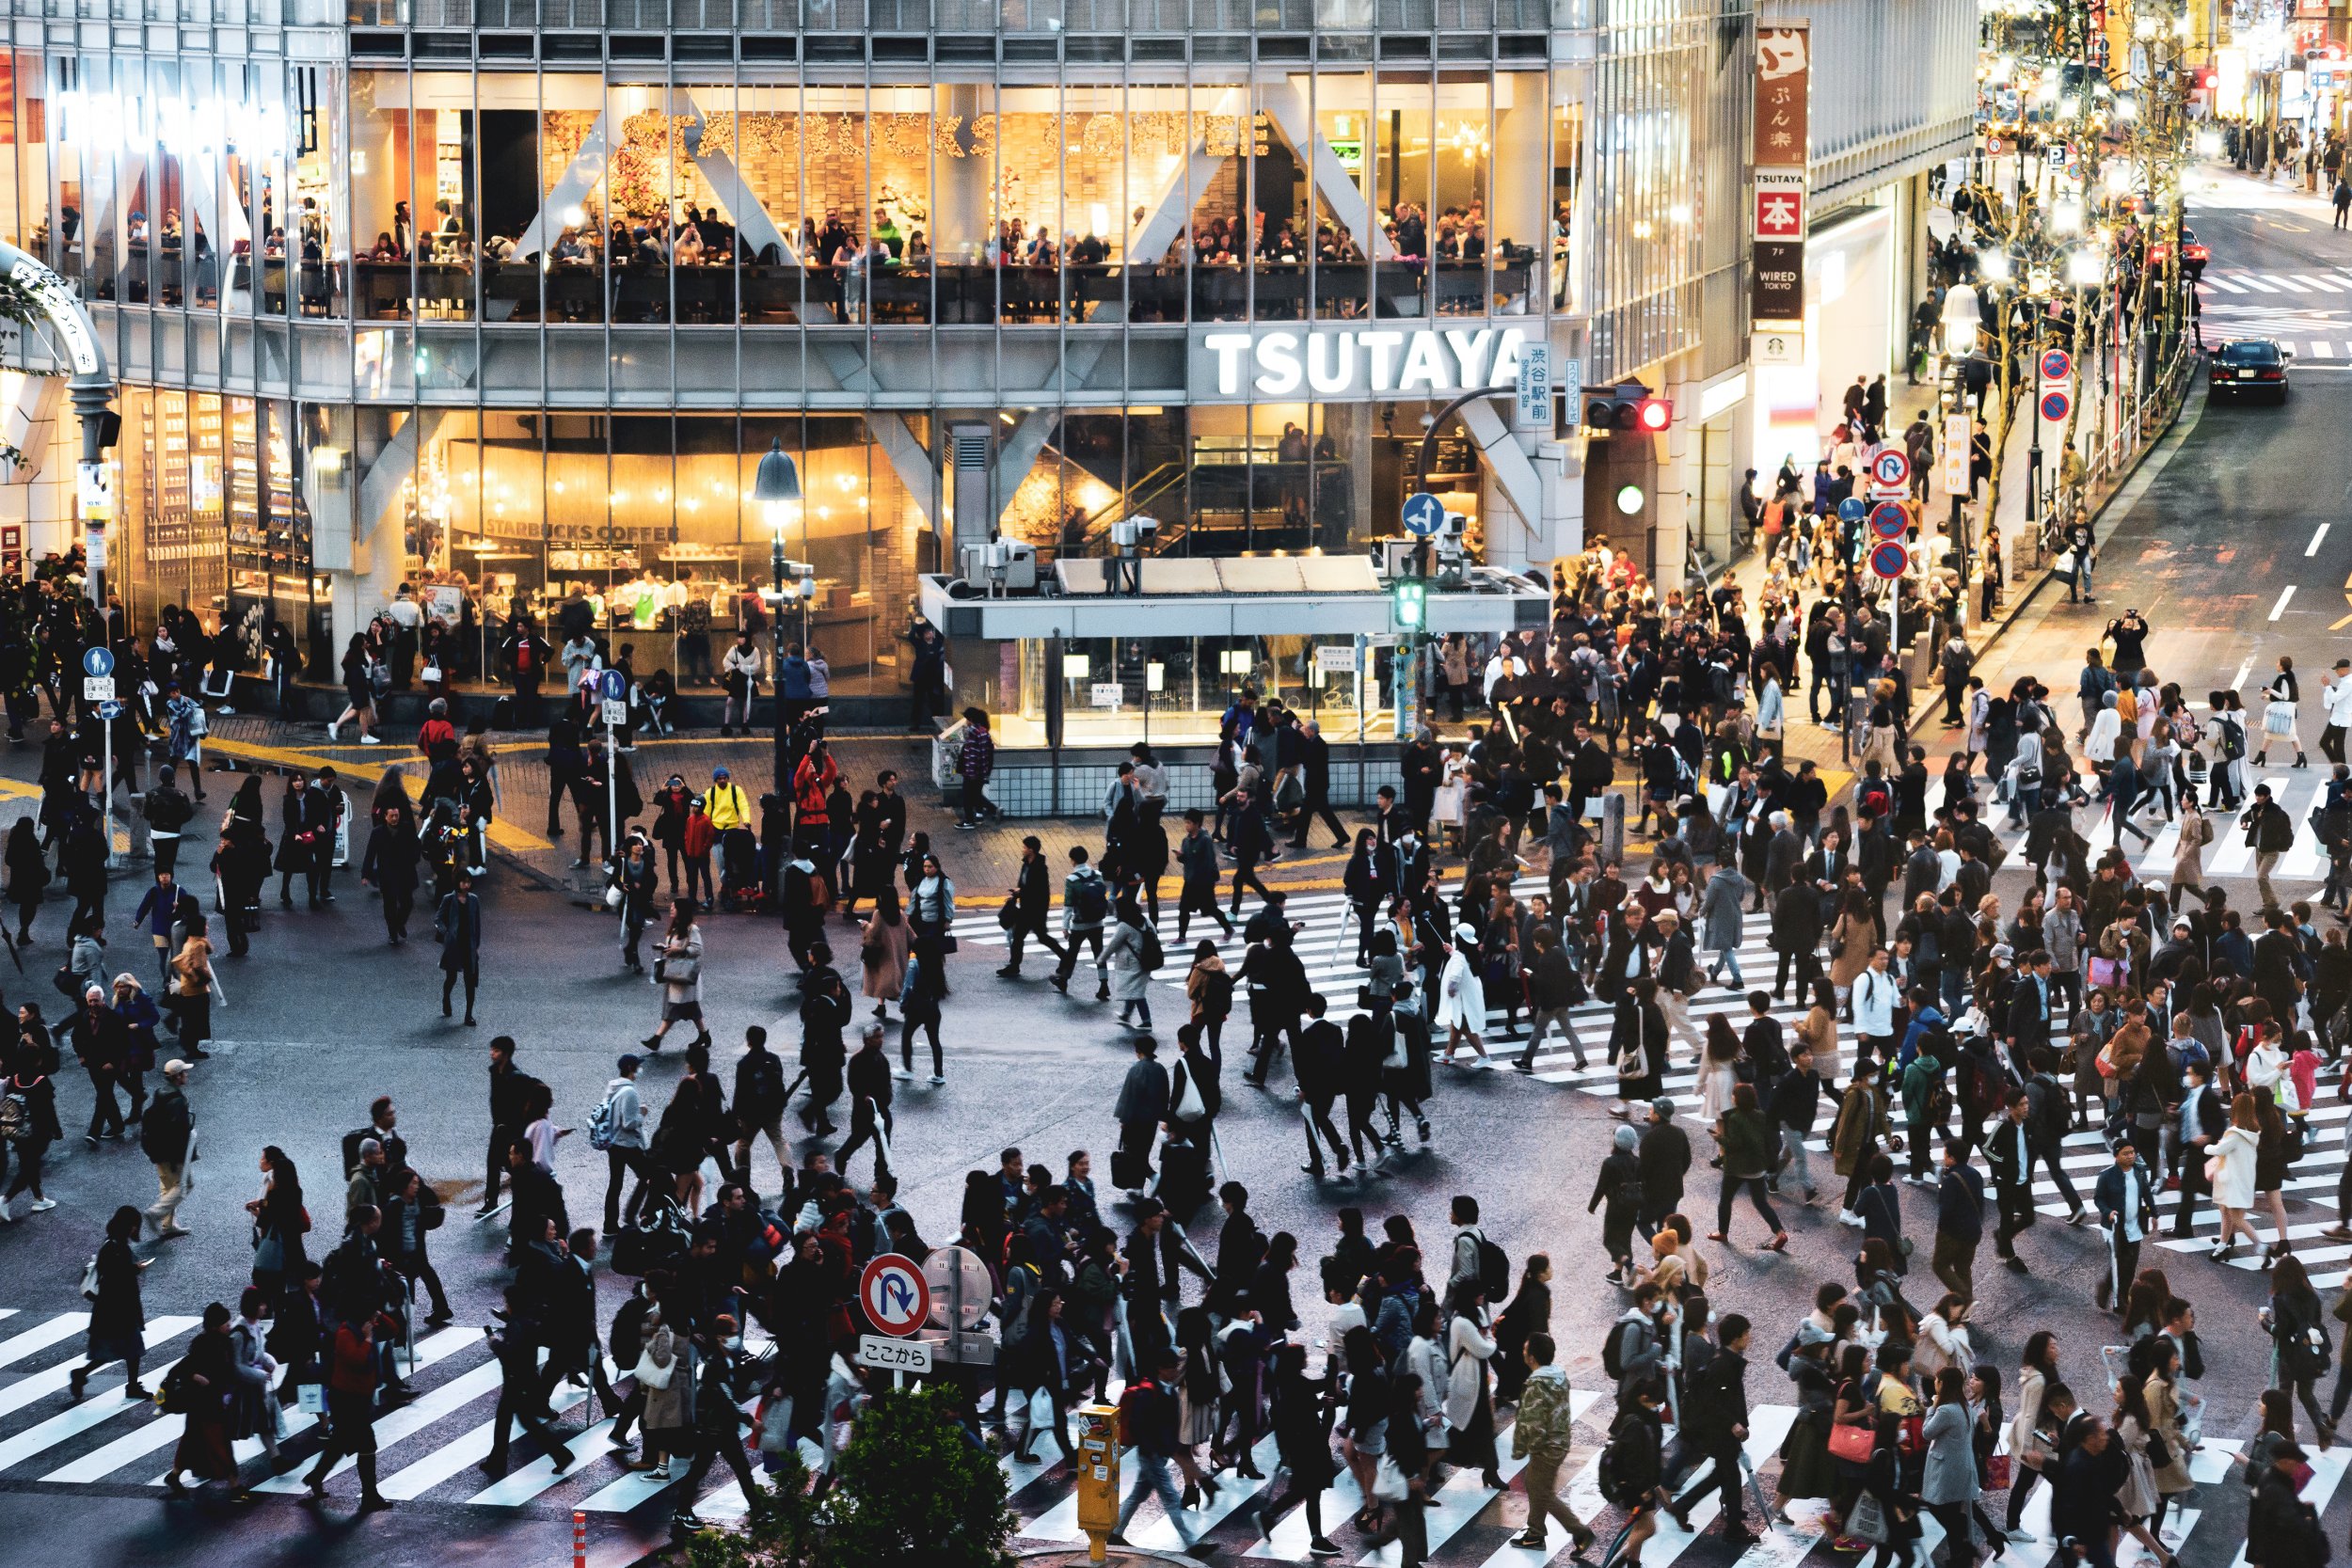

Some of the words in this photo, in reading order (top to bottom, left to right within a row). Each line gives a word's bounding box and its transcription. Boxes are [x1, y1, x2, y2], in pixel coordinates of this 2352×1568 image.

[1770, 87, 1792, 148] ぷん楽
[622, 114, 1001, 158] STARBUCKS
[1044, 114, 1269, 157] COFFEE
[1756, 175, 1803, 183] TSUTAYA
[1762, 197, 1796, 230] 本
[1772, 247, 1785, 256] 7F
[1759, 271, 1797, 282] WIRED
[1764, 282, 1791, 291] TOKYO
[1205, 329, 1524, 394] TSUTAYA
[1520, 358, 1530, 391] Shibuya
[1531, 348, 1547, 420] 渋谷駅前
[1568, 363, 1578, 420] スクランブル式
[486, 518, 593, 540] STARBUCKS
[596, 525, 679, 543] COFFEE
[1400, 646, 1406, 655] 6
[866, 1343, 926, 1367] ここから
